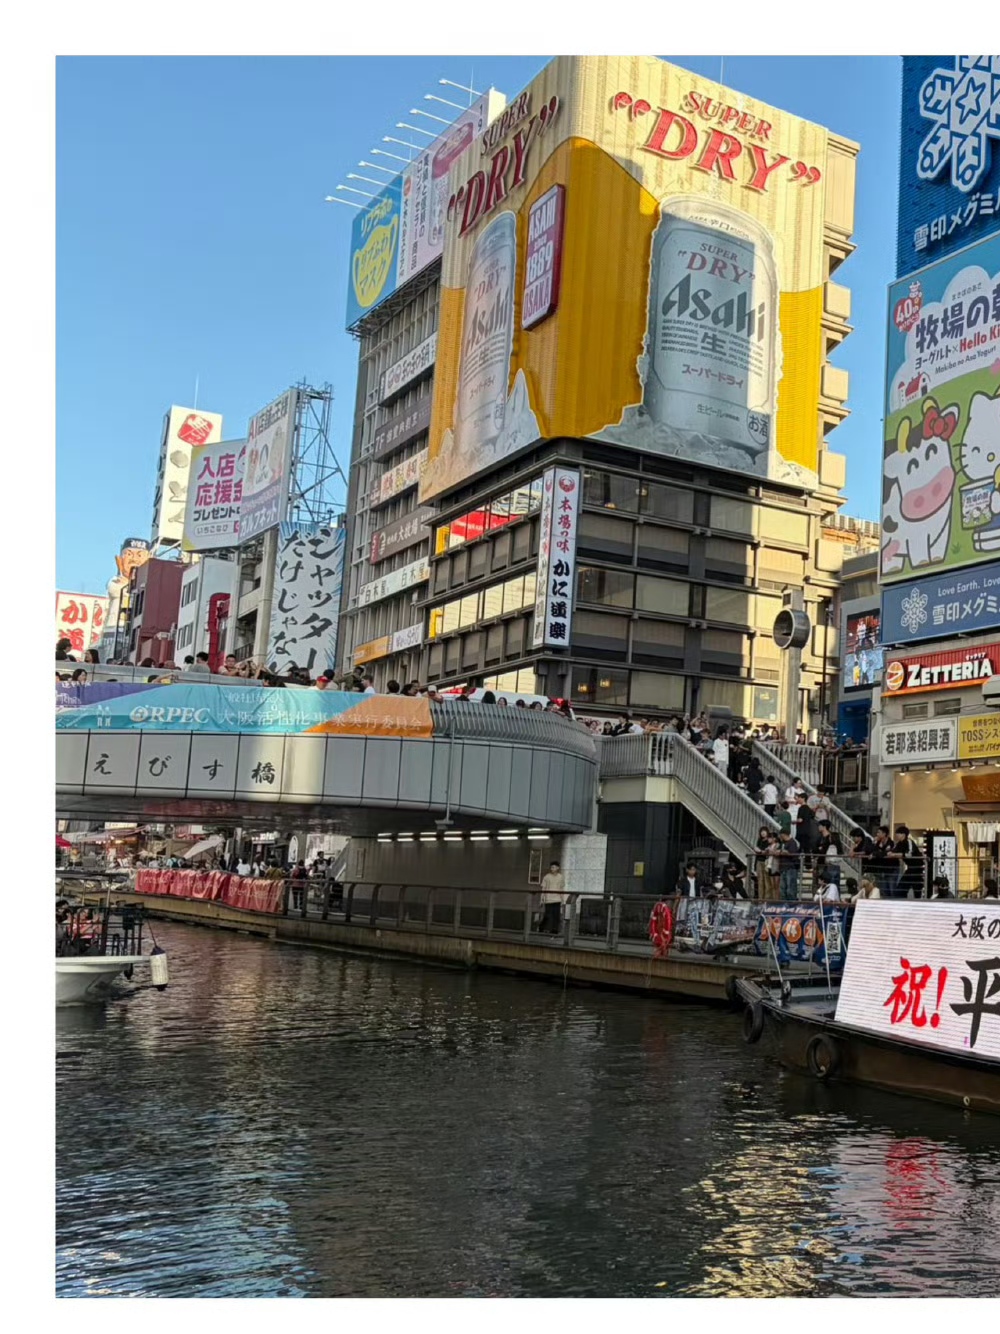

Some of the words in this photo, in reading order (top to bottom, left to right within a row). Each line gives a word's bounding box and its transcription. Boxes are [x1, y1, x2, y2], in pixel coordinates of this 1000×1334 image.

[481, 91, 531, 156] SUPER
[684, 90, 773, 140] SUPER
[529, 195, 557, 244] ASAHI
[526, 241, 554, 285] 1889
[700, 243, 738, 262] SUPER
[523, 276, 551, 321] OSAKA
[661, 273, 766, 342] Asahi
[700, 332, 726, 356] 生
[960, 331, 987, 352] Hello
[977, 345, 997, 358] Yogurt
[682, 363, 743, 388] スーパードライ
[197, 453, 236, 480] 入店
[301, 528, 339, 671] シャッター
[549, 558, 571, 640] かに道楽
[938, 586, 955, 597] Love
[957, 580, 980, 593] Earth.
[983, 576, 1000, 587] Love
[907, 658, 993, 687] ZETTERIA
[93, 753, 276, 784] えびす橋
